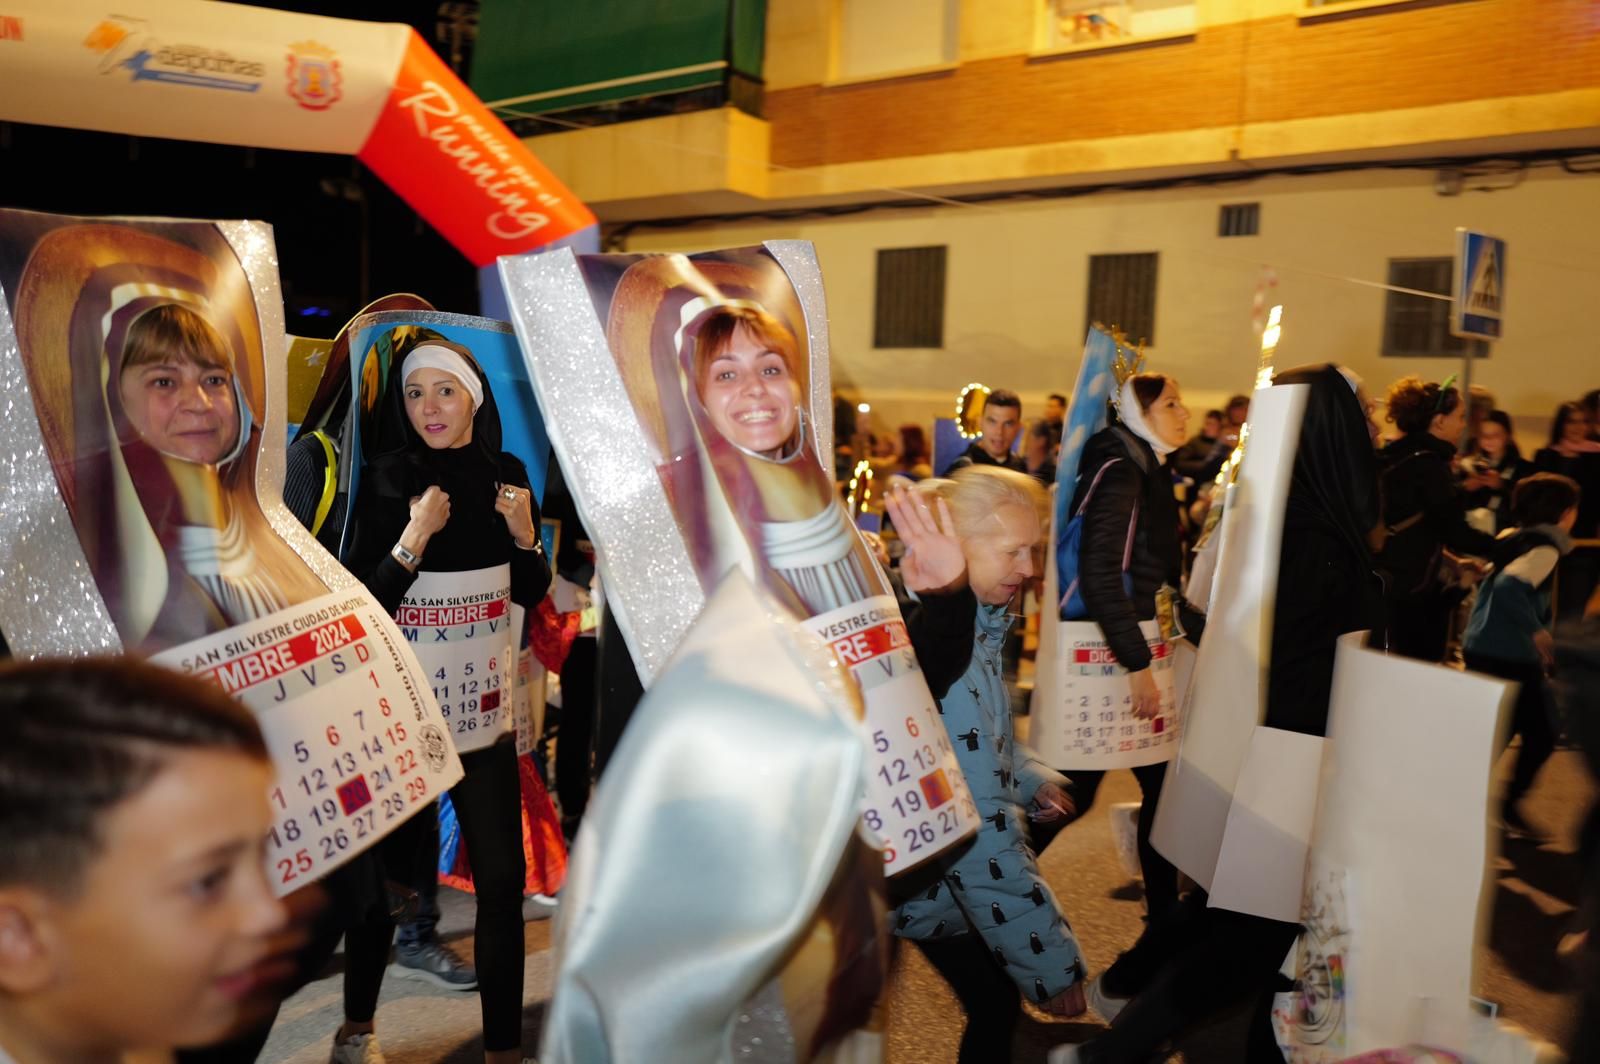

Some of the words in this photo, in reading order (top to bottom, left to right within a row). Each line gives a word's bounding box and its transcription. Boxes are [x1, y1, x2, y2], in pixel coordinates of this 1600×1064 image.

[398, 80, 550, 240] Running
[420, 597, 443, 607] SAN
[447, 591, 495, 606] SILVESTRE
[181, 648, 221, 674] SAN
[225, 622, 292, 657] SILVESTRE
[293, 609, 329, 632] CIUDAD
[328, 603, 342, 617] DE
[310, 620, 352, 656] 2024
[369, 613, 404, 673] Rosario
[403, 627, 418, 642] M
[435, 627, 448, 642] X
[465, 624, 475, 638] J
[489, 620, 498, 633] V
[274, 679, 287, 702] J
[301, 664, 317, 687] V
[331, 654, 346, 674] S
[354, 643, 369, 664] D
[369, 669, 380, 688] 1
[435, 666, 446, 680] 4
[464, 662, 474, 676] 5
[488, 656, 497, 671] 6
[877, 655, 893, 678] V
[1080, 665, 1090, 676] L
[402, 675, 425, 722] Santo
[459, 680, 478, 695] 12
[484, 674, 499, 690] 13
[458, 699, 478, 714] 19
[1080, 695, 1088, 707] 2
[1102, 695, 1111, 707] 3
[1123, 695, 1131, 705] 4
[1098, 711, 1113, 722] 10
[294, 740, 309, 763] 5
[326, 724, 340, 747] 6
[353, 709, 365, 731] 7
[379, 697, 392, 718] 8
[457, 717, 477, 733] 26
[482, 711, 498, 727] 27
[873, 730, 889, 753] 5
[905, 716, 919, 738] 6
[1074, 726, 1092, 738] 16
[1098, 726, 1114, 738] 17
[299, 768, 327, 796] 12
[332, 752, 356, 778] 13
[361, 735, 383, 761] 14
[386, 721, 408, 746] 15
[878, 758, 910, 787] 12
[913, 744, 936, 770] 13
[269, 818, 301, 849] 18
[309, 799, 337, 827] 19
[370, 764, 393, 791] 21
[395, 749, 418, 775] 22
[892, 790, 921, 818] 19
[277, 848, 313, 884] 25
[319, 828, 349, 860] 26
[353, 808, 375, 839] 27
[381, 791, 404, 820] 28
[406, 776, 427, 803] 29
[904, 821, 935, 853] 26
[938, 804, 960, 835] 27
